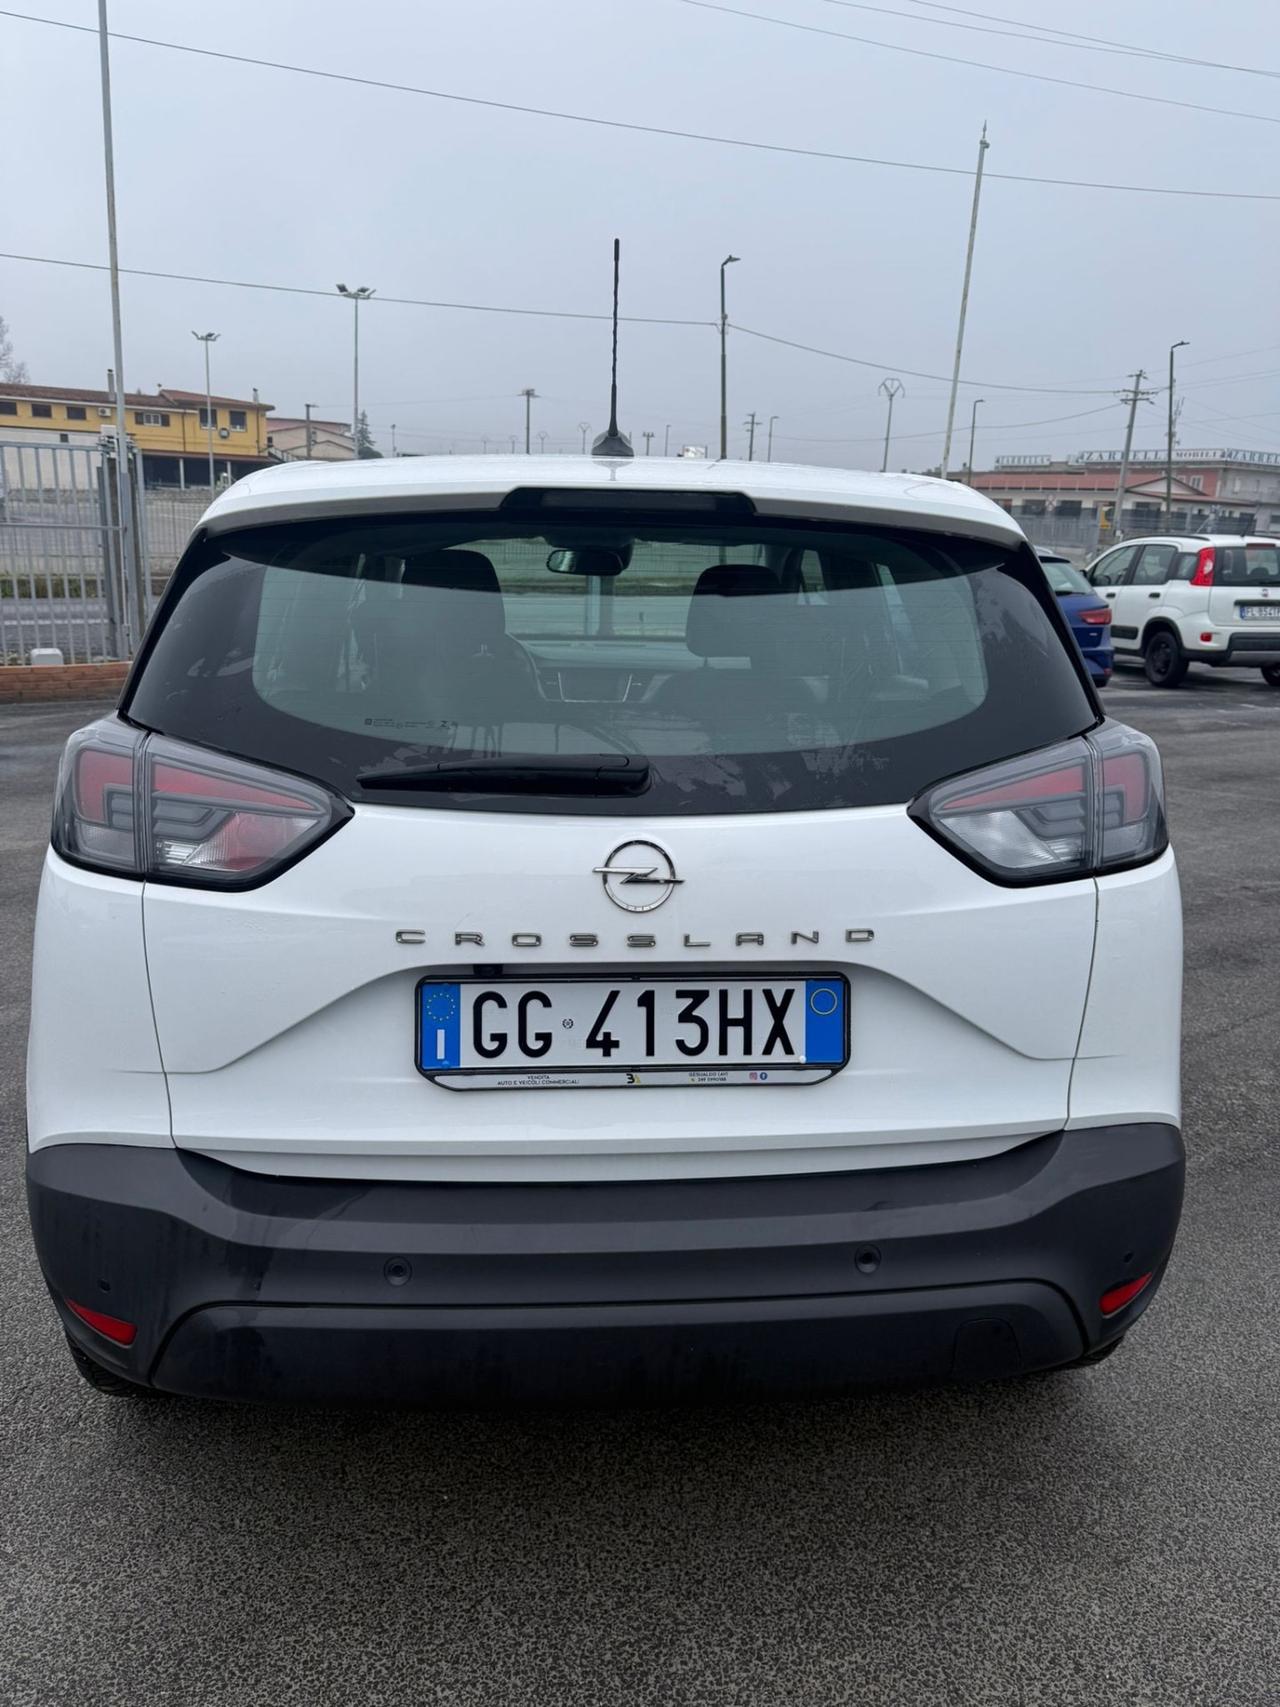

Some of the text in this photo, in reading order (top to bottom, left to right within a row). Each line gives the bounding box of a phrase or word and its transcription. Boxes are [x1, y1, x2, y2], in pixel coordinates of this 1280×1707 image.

[1086, 450, 1169, 461] ZARELL
[395, 928, 875, 947] CROSSLAND
[472, 990, 553, 1059] GG
[585, 988, 796, 1058] 413HX
